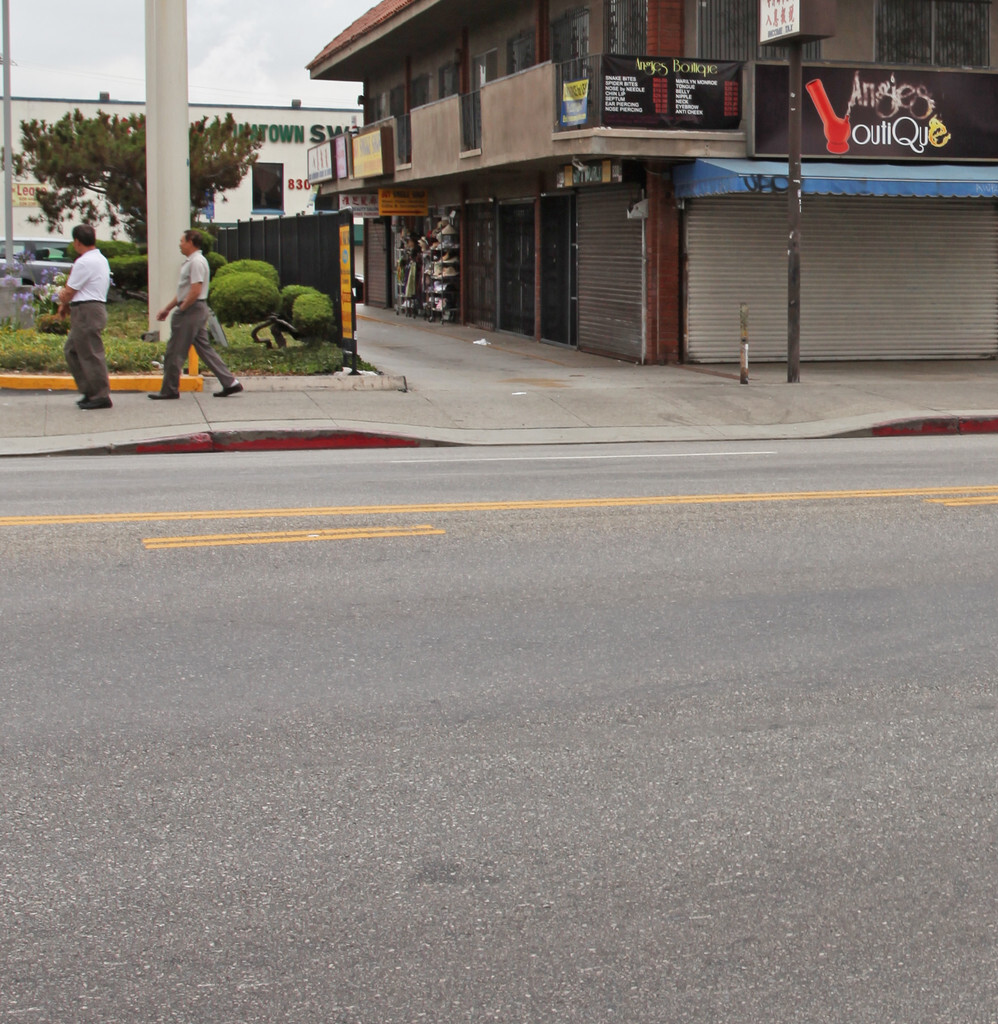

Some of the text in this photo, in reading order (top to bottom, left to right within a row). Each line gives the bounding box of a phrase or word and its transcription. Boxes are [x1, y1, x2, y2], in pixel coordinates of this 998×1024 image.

[785, 24, 793, 33] TAX
[673, 59, 718, 77] Boutique
[309, 124, 351, 144] SW
[288, 179, 310, 190] 830
